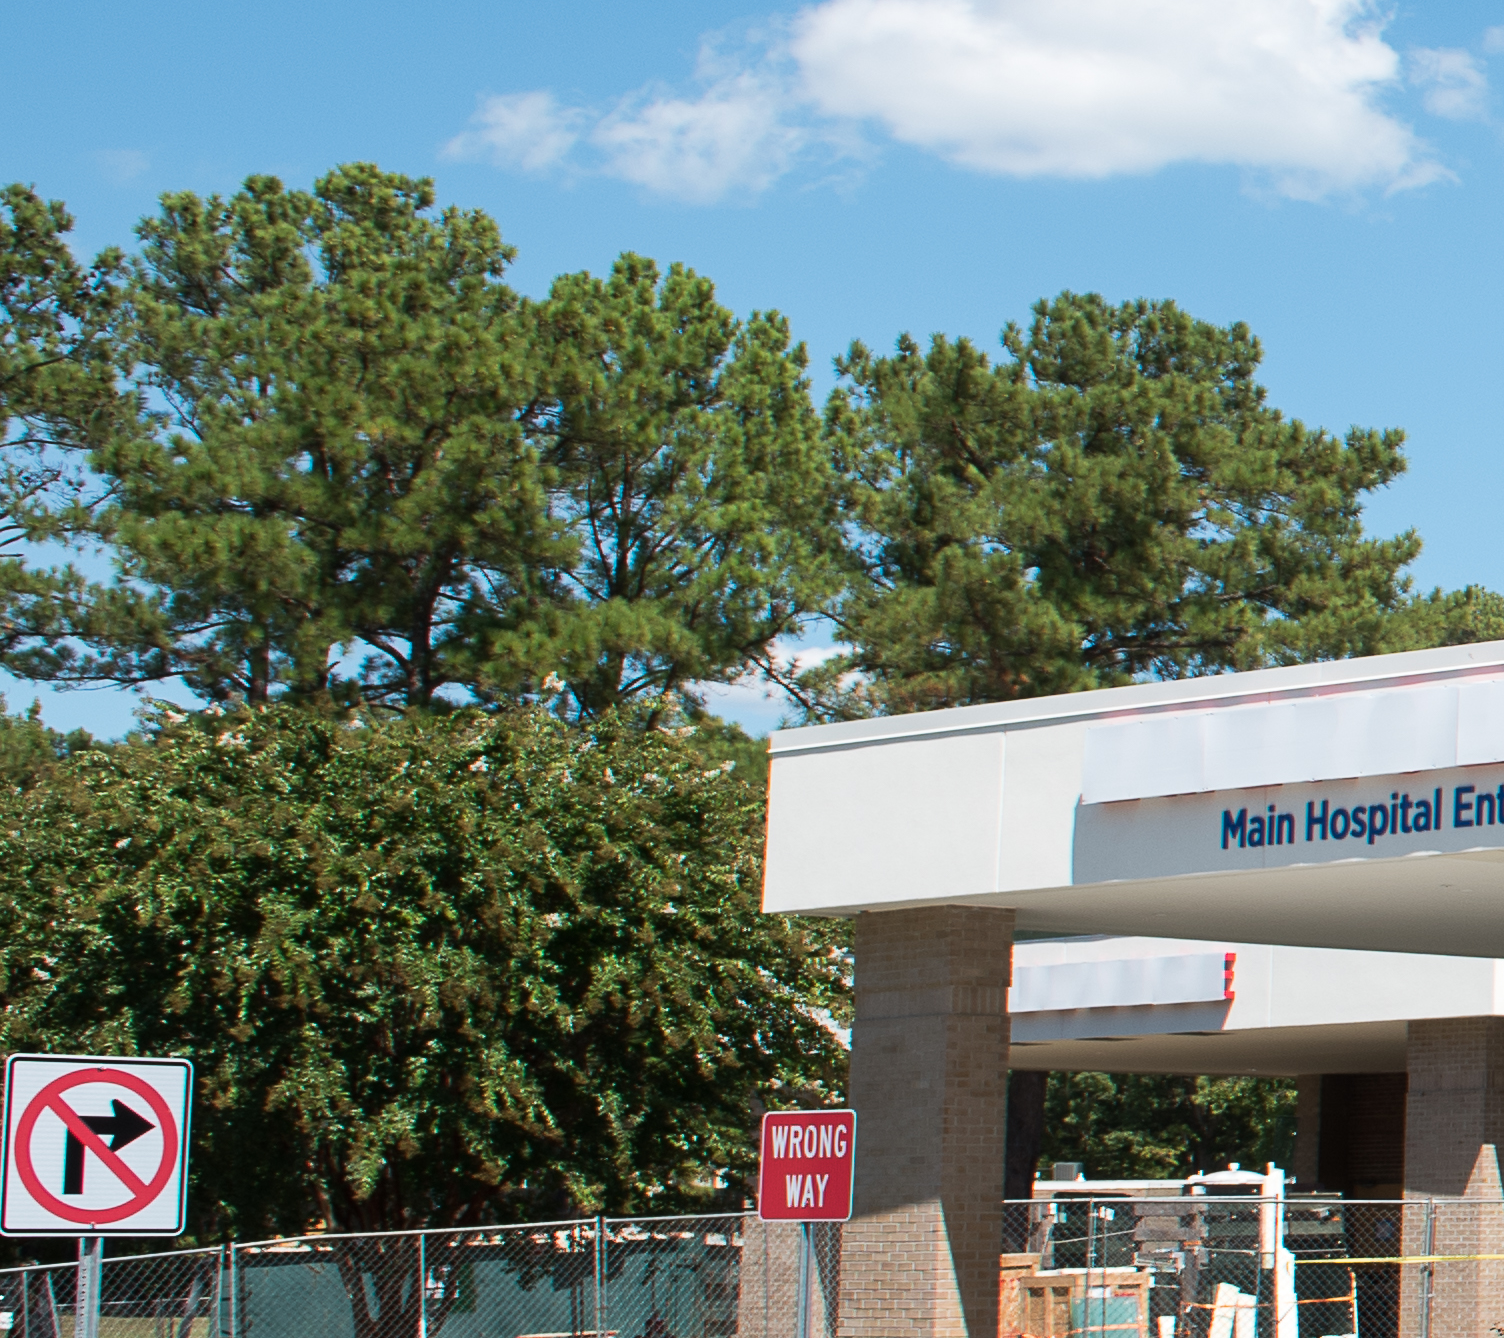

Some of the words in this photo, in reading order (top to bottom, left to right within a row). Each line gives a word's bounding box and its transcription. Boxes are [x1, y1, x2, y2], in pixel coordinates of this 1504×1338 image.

[1221, 804, 1295, 850] Main
[1305, 787, 1444, 845] Hospital
[772, 1124, 847, 1158] WRONG
[786, 1174, 829, 1208] WAY
